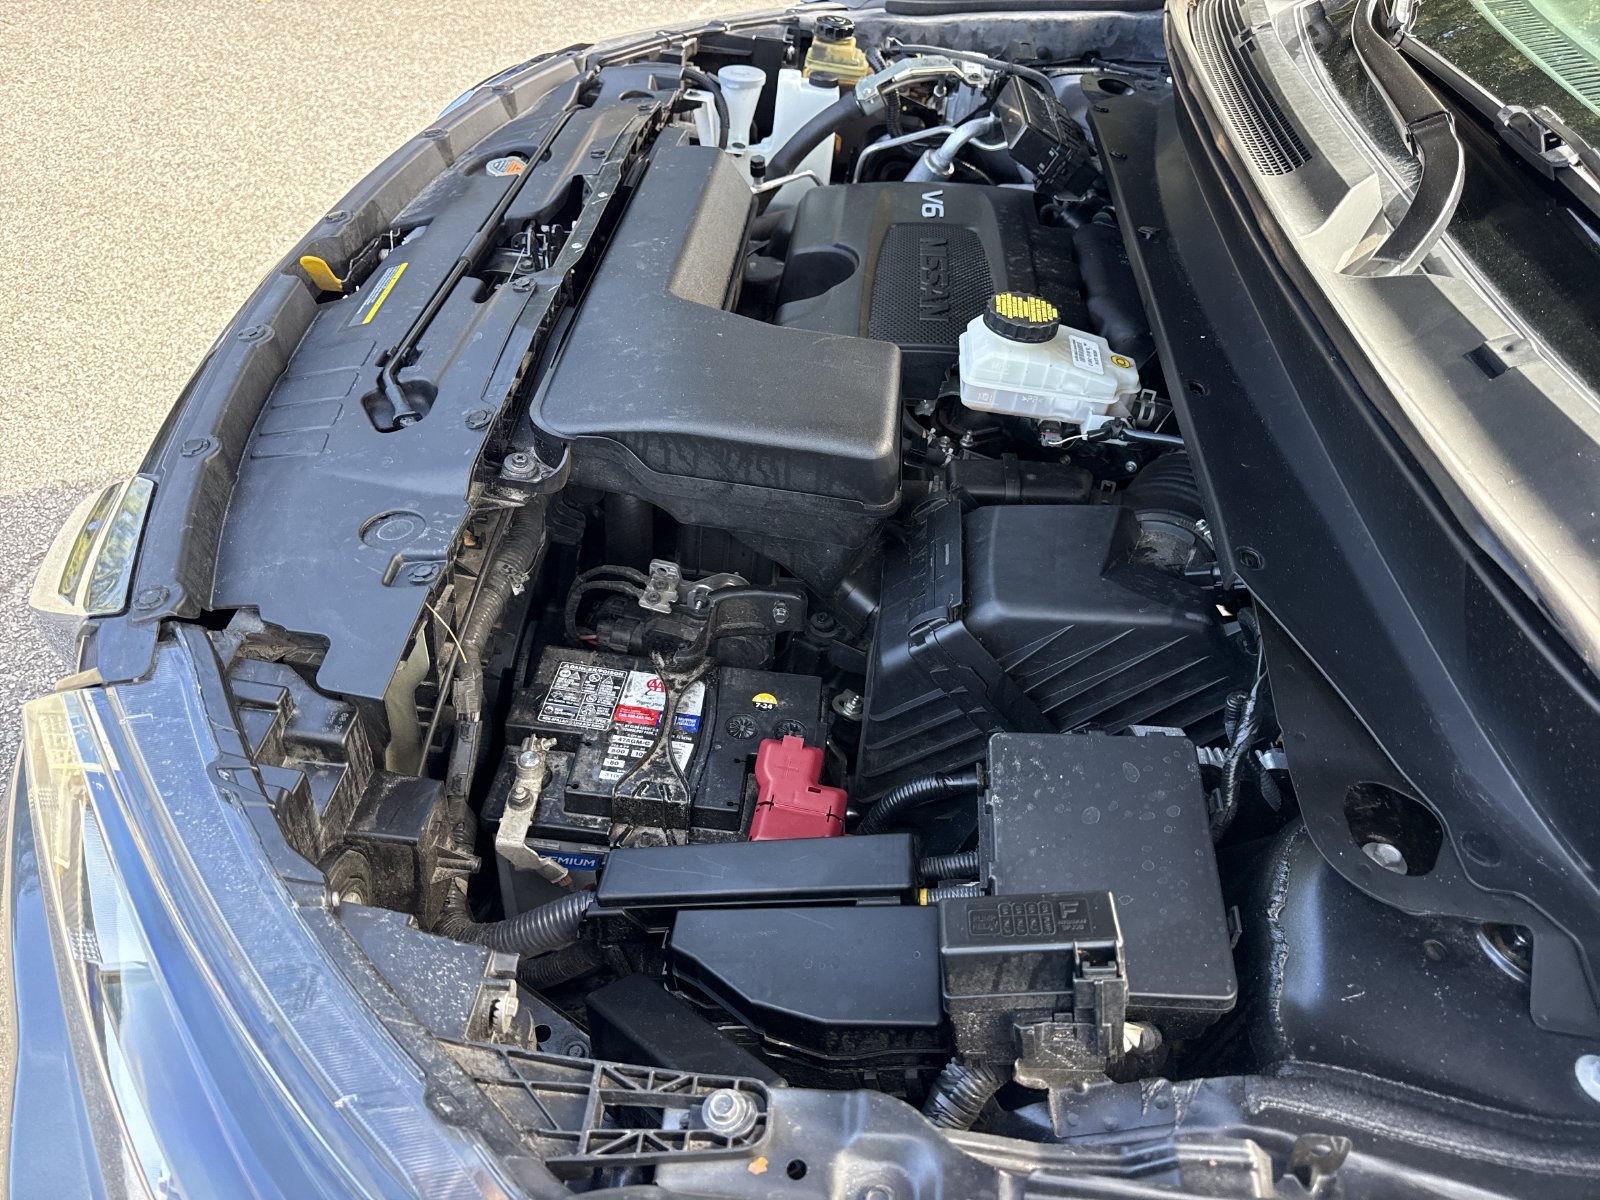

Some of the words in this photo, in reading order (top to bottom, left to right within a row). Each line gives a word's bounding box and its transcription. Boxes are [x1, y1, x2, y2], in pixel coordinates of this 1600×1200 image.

[921, 189, 945, 219] V6
[919, 237, 950, 321] NISSAN
[646, 678, 665, 693] AA
[541, 855, 596, 867] EMIUM
